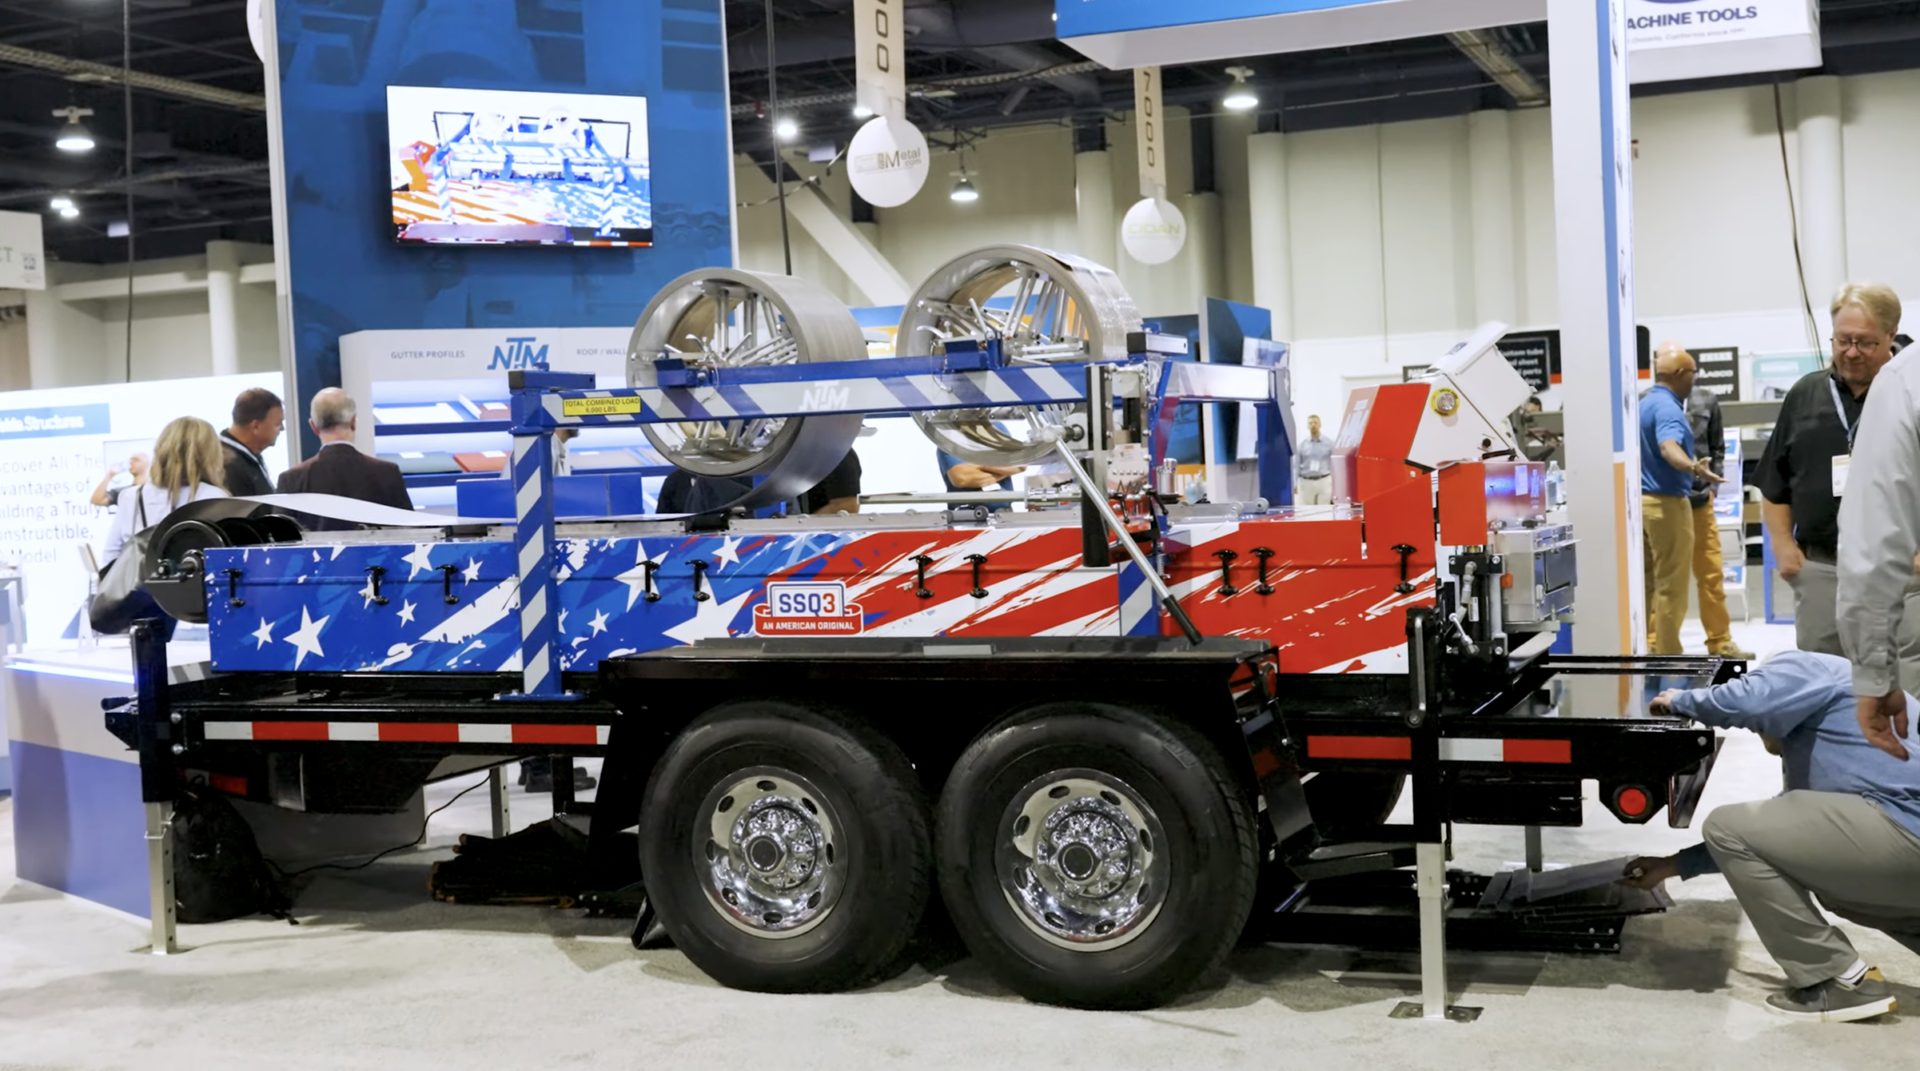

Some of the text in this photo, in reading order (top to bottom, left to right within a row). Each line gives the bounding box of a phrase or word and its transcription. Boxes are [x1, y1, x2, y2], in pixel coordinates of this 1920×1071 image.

[1697, 6, 1758, 23] TOOLS
[875, 0, 889, 73] 00
[1143, 70, 1155, 167] 7000
[391, 350, 465, 359] GUTTER PROFILES
[487, 337, 549, 370] NTM
[586, 398, 620, 407] COMBINED
[621, 398, 640, 406] LOAD
[799, 381, 850, 411] NTM
[0, 459, 43, 473] cover
[50, 455, 68, 470] All
[76, 477, 90, 493] of
[50, 505, 58, 517] a
[64, 500, 100, 520] Truly
[779, 593, 836, 617] SSQ3
[762, 621, 855, 631] AN AMERICAN ORIGINAL
